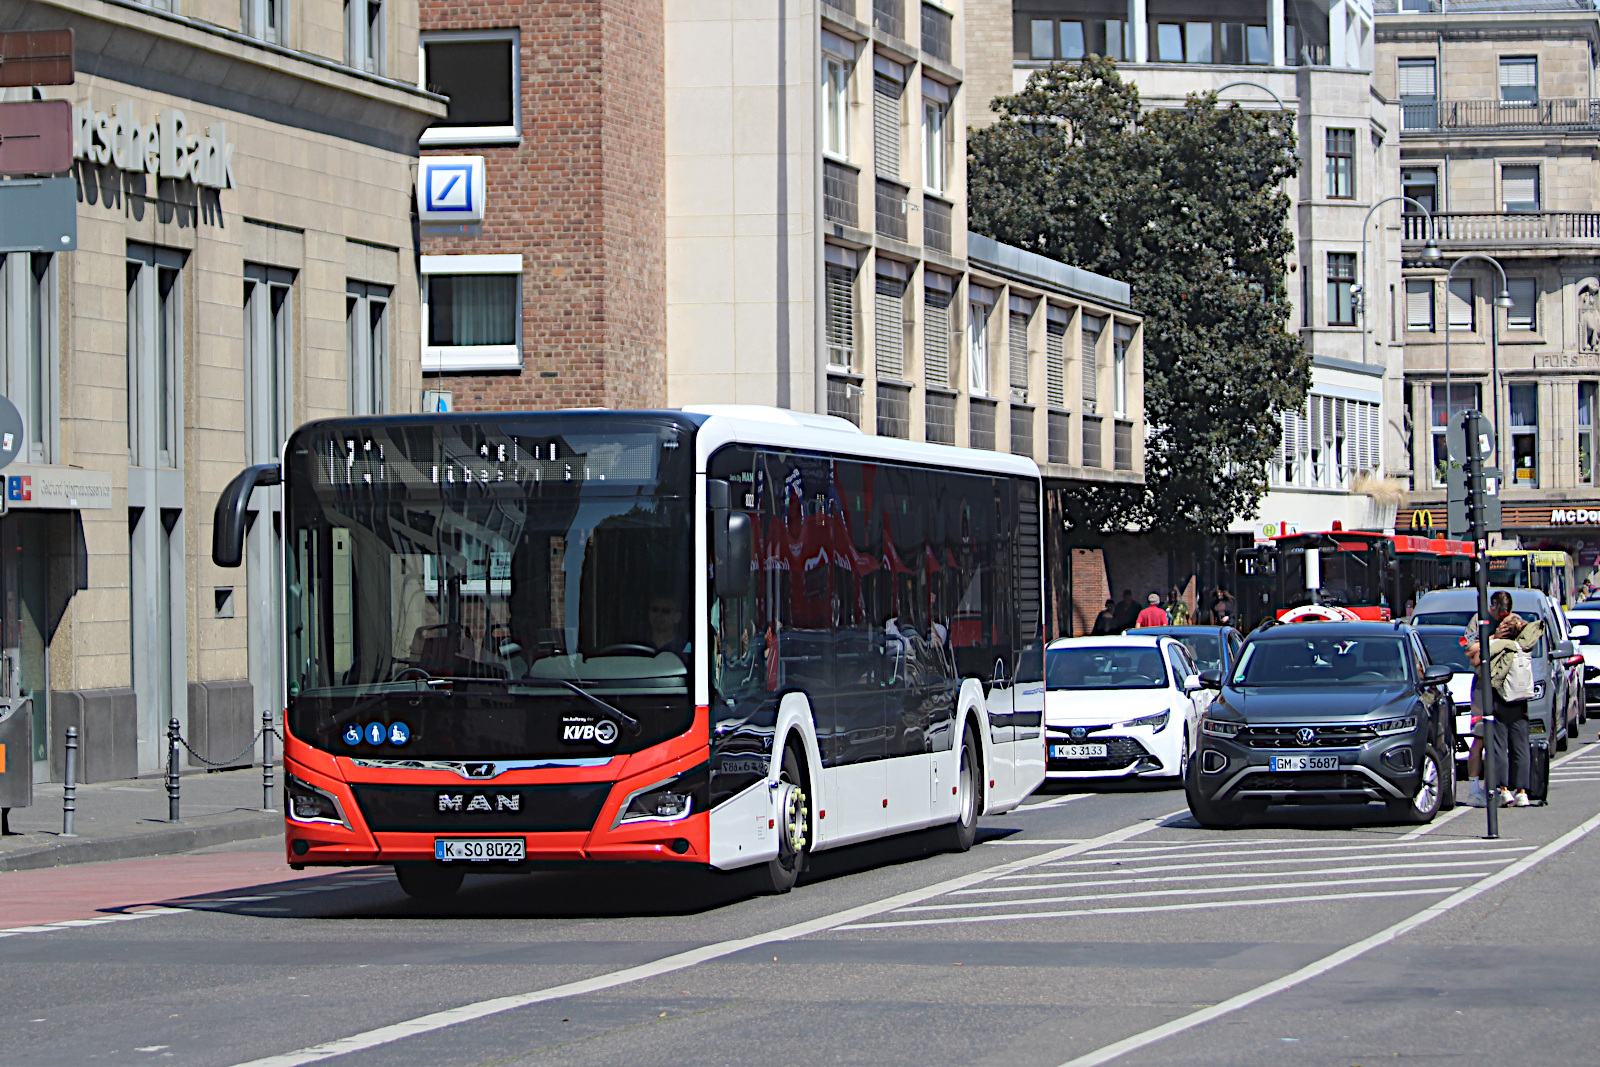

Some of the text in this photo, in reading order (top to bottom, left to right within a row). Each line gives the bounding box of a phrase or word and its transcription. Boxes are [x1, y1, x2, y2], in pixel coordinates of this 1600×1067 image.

[160, 109, 236, 189] Bank
[741, 471, 754, 483] MAN
[1551, 509, 1600, 522] McDo
[563, 725, 595, 740] KVB
[1058, 745, 1103, 756] K S 3133
[1276, 757, 1337, 770] GM S 5687
[438, 794, 520, 811] MAN
[445, 842, 455, 857] K
[464, 842, 483, 857] SO
[486, 842, 522, 857] 8022
